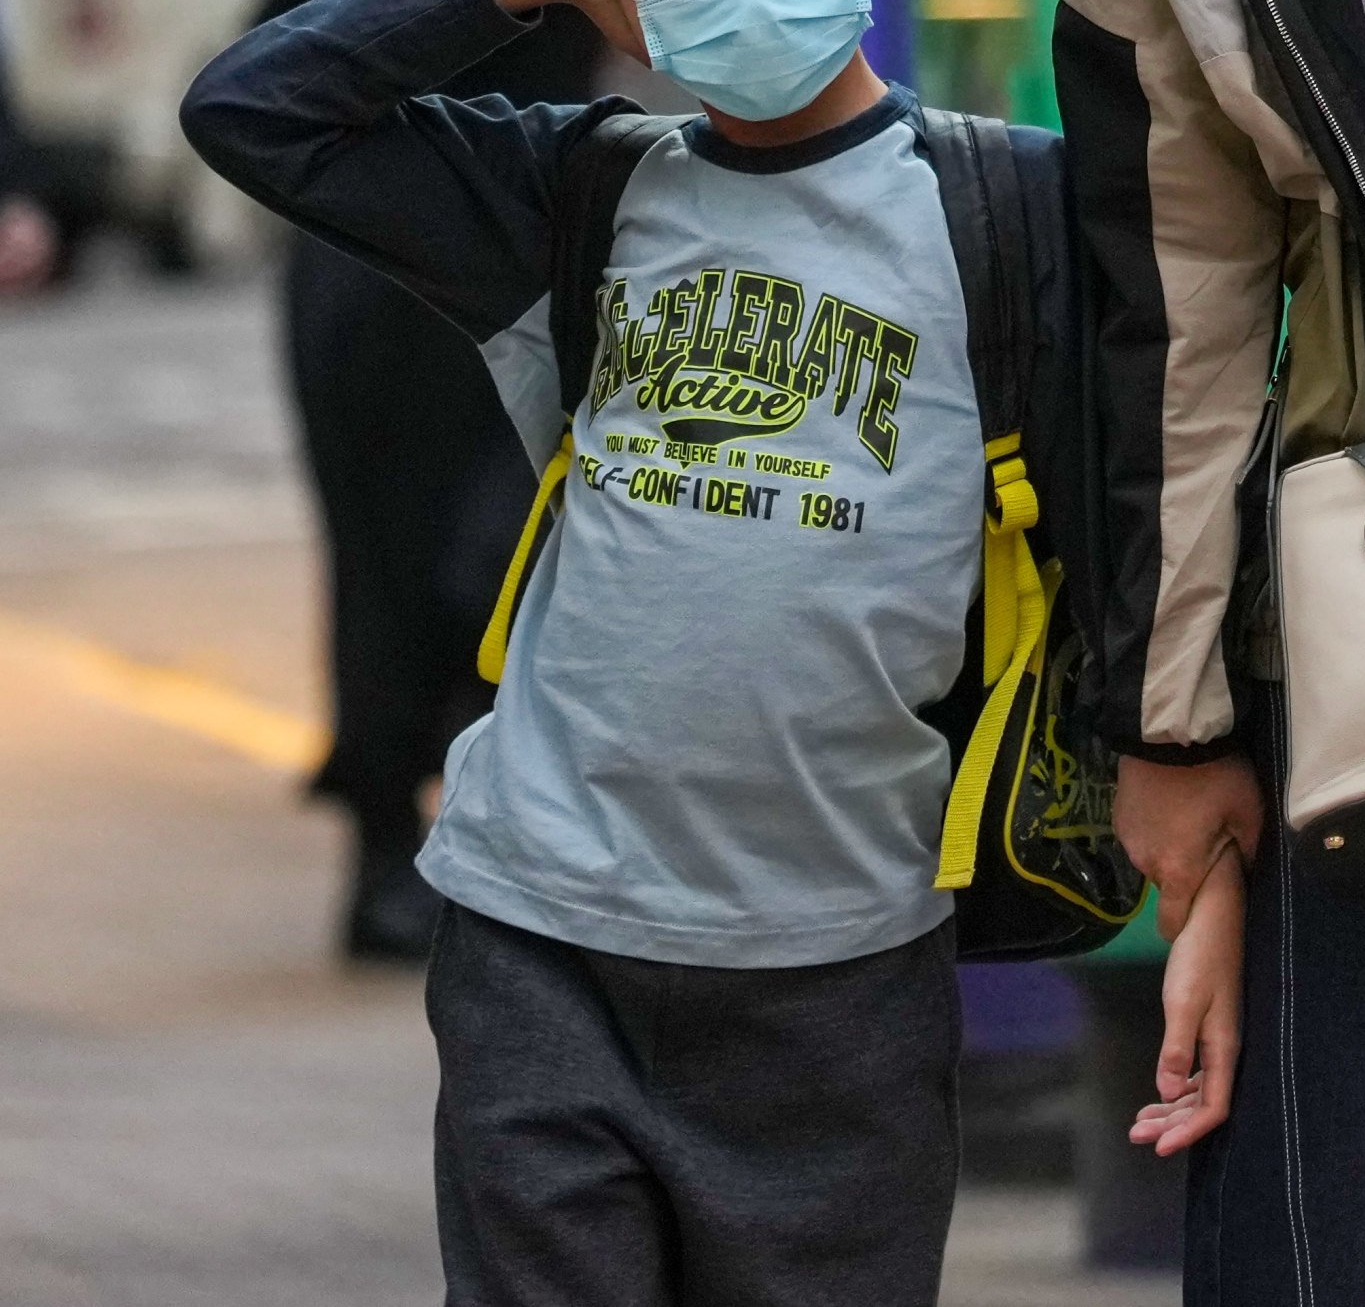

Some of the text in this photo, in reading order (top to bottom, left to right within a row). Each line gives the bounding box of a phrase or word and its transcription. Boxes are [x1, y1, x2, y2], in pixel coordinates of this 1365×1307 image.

[636, 352, 805, 421] Active
[605, 435, 831, 479] YOU MUST BELIEVE IN YOURSELF
[800, 492, 865, 534] 1981
